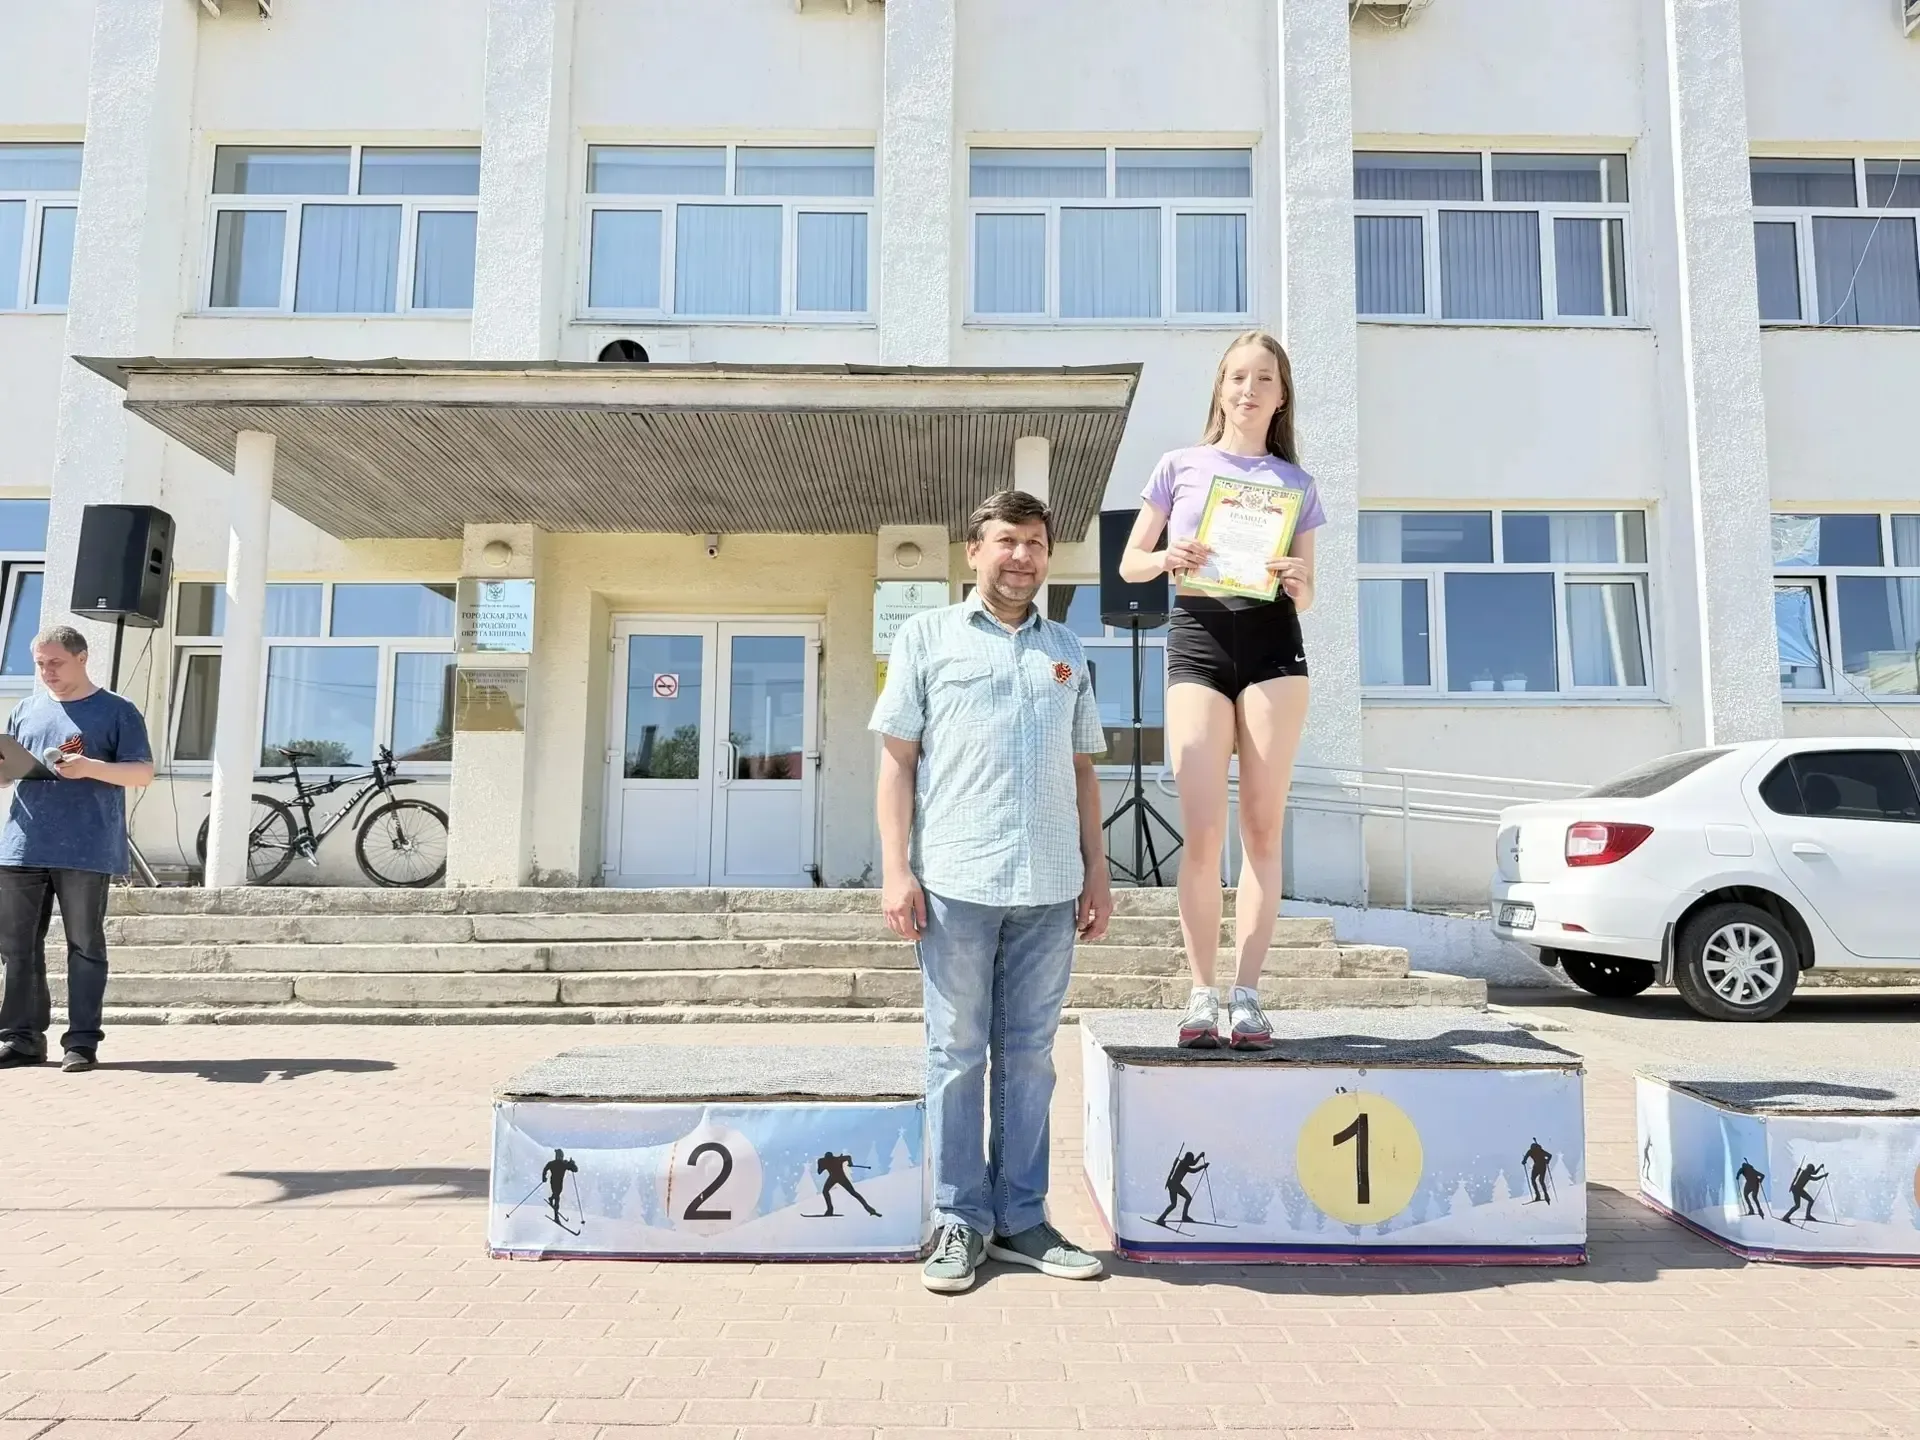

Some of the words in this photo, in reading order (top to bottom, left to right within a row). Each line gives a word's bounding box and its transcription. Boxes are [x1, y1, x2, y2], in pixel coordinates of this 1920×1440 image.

[461, 612, 505, 620] ГОРОДСКАЯ
[505, 612, 528, 620] ДУМА
[472, 622, 517, 630] ГОРОДСКОГО
[1333, 1112, 1370, 1204] 1
[683, 1142, 733, 1220] 2
